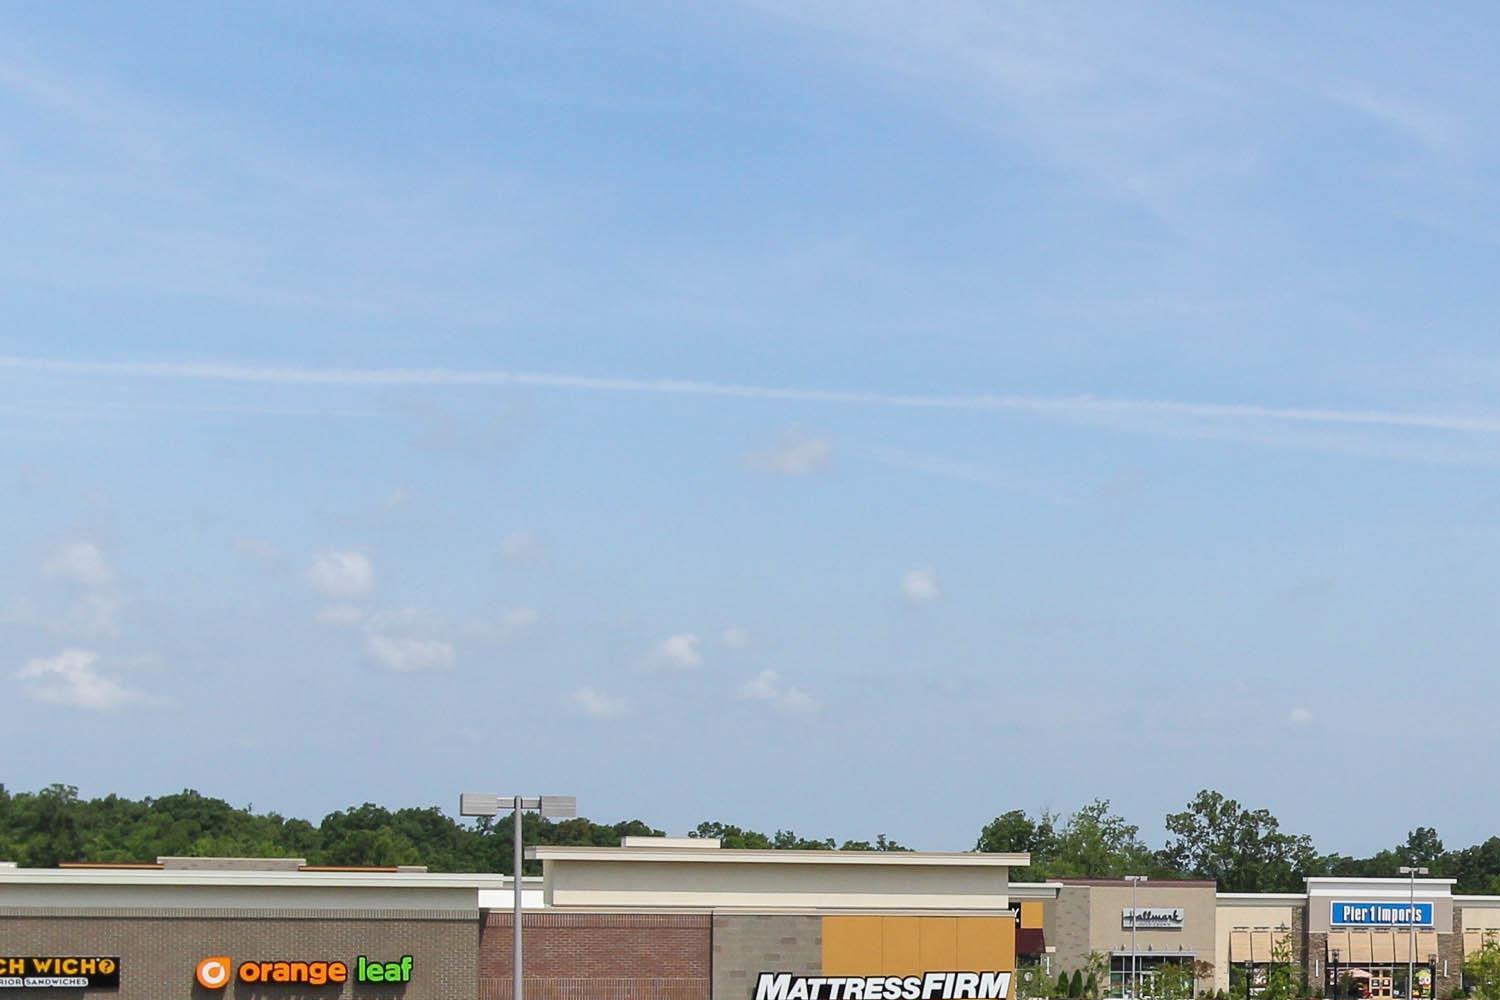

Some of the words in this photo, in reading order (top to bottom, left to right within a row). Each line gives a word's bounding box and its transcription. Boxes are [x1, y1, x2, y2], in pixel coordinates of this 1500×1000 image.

[1343, 905, 1367, 922] Pier
[1377, 906, 1422, 923] Imports
[238, 961, 348, 985] orange
[357, 955, 413, 982] leaf
[26, 978, 88, 986] SANDWICHES
